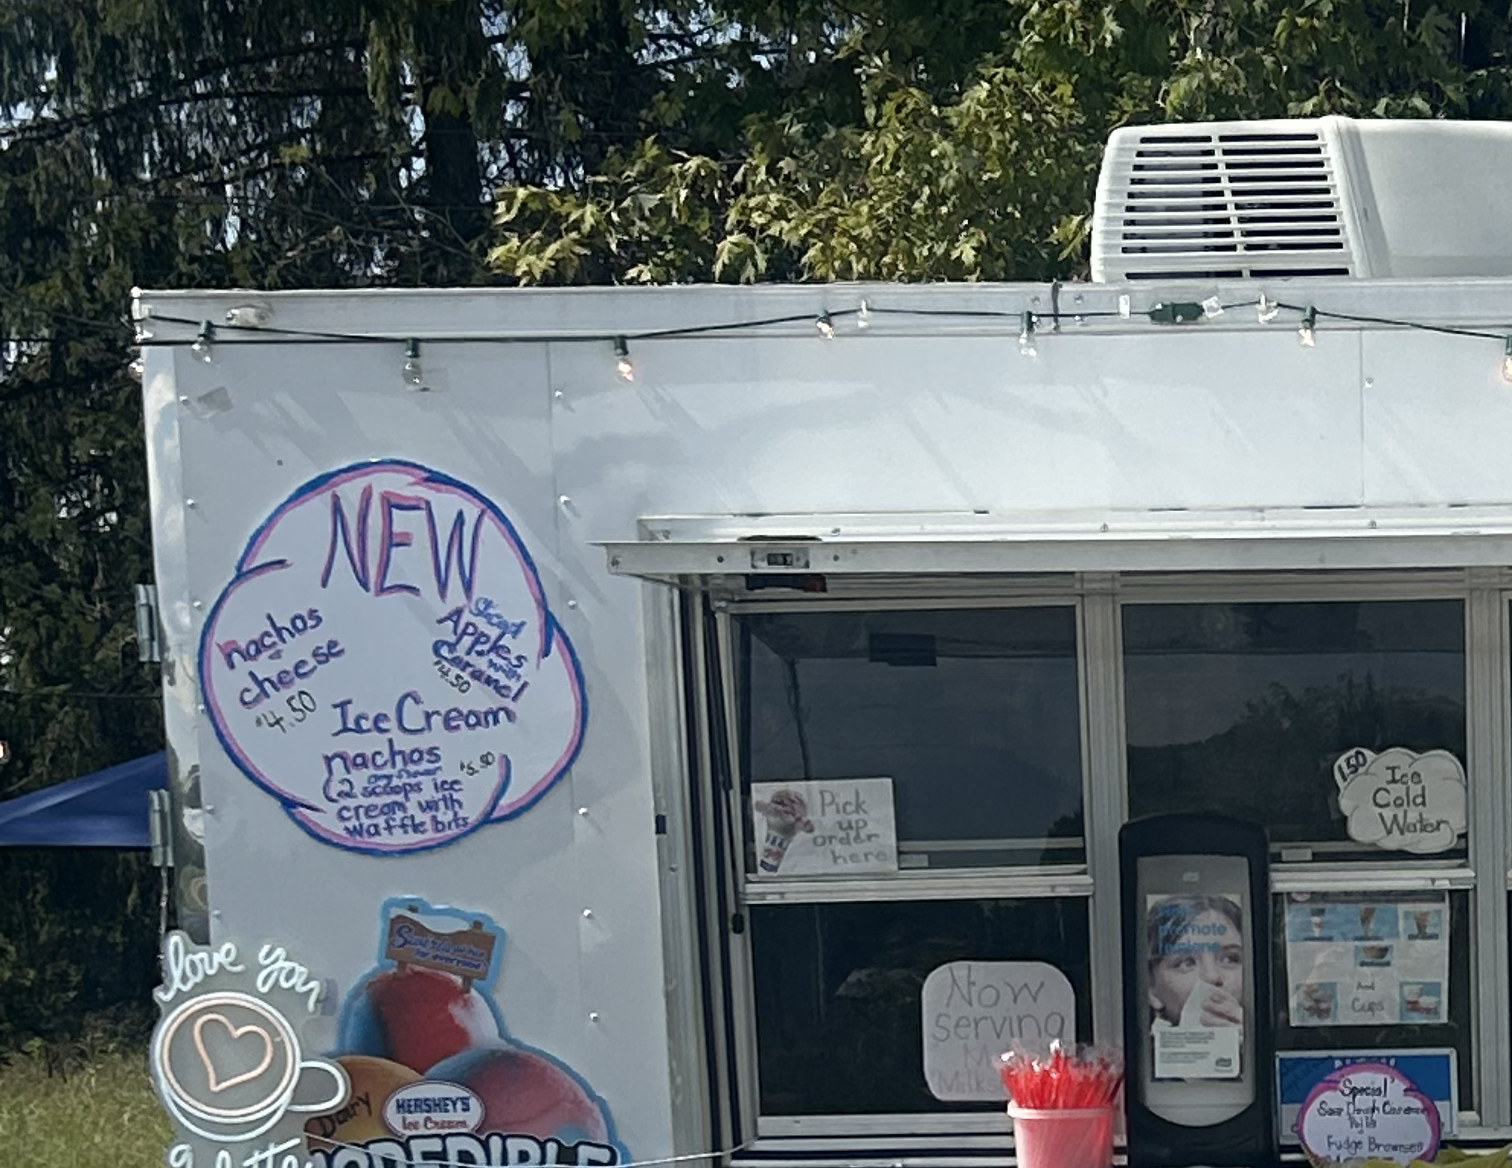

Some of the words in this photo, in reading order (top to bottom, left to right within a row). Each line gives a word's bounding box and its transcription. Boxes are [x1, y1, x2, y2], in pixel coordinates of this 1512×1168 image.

[321, 483, 486, 602] NEW
[216, 607, 323, 669] nachos
[436, 604, 527, 669] Apples
[239, 638, 345, 709] cheese
[432, 639, 530, 703] Caramel
[332, 699, 390, 736] Ice
[396, 690, 515, 735] Cream
[322, 738, 441, 776] nachos
[1385, 766, 1422, 786] Ice
[337, 778, 357, 799] 2
[361, 782, 423, 801] scoops
[433, 778, 463, 792] ice
[1373, 788, 1426, 809] Cold
[337, 801, 407, 822] cream
[417, 793, 463, 812] with
[820, 789, 868, 817] Pick
[344, 814, 427, 838] waffle
[430, 813, 469, 833] bits
[838, 819, 868, 834] up
[1378, 811, 1450, 836] Water
[812, 830, 880, 848] order
[831, 849, 888, 865] here
[1158, 922, 1227, 939] promote
[155, 932, 243, 1001] love
[256, 944, 320, 1011] you
[946, 964, 1044, 1008] Now
[396, 1096, 470, 1114] HERSHEY'S
[402, 1116, 420, 1130] Ice
[424, 1116, 469, 1130] Cream
[1327, 1135, 1363, 1154] Fudge
